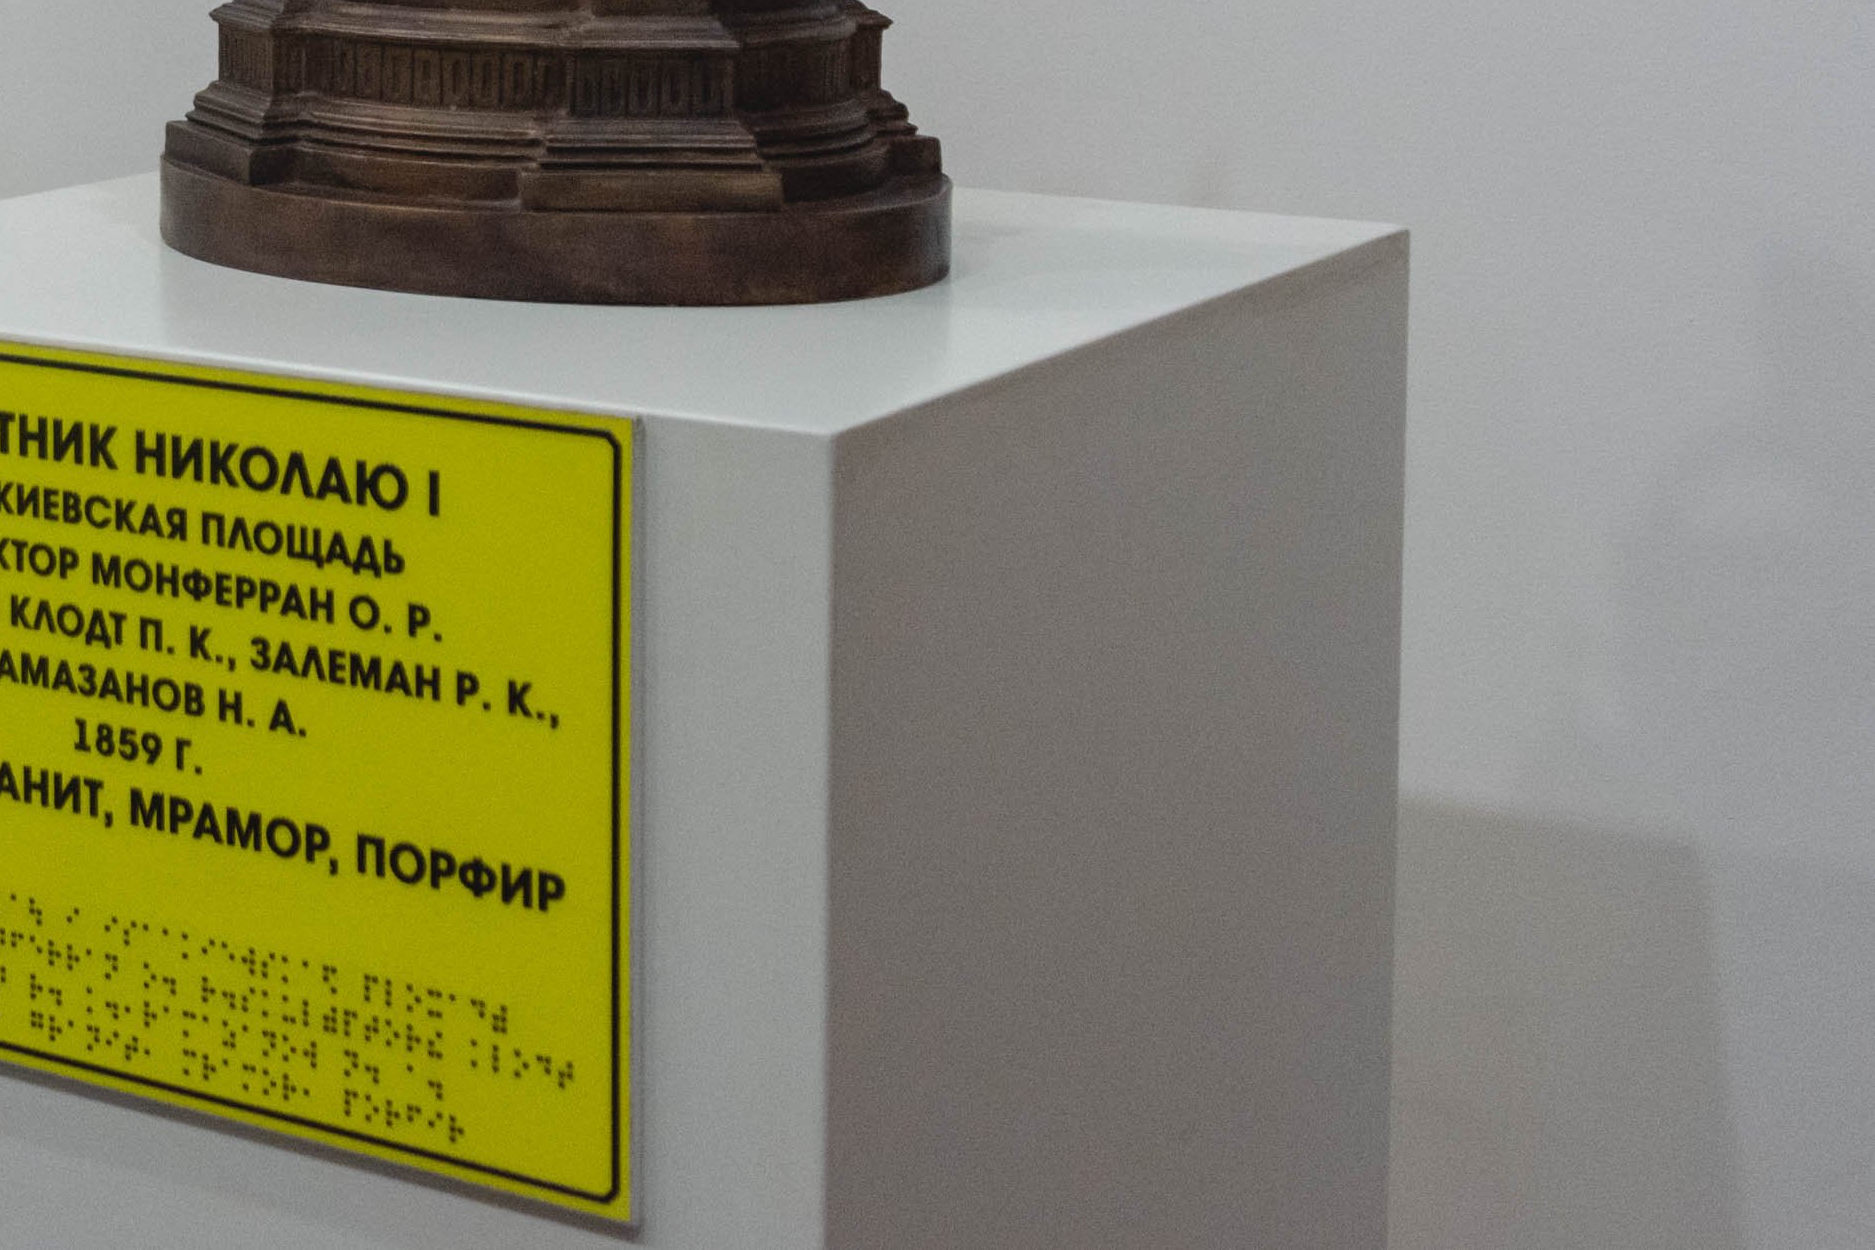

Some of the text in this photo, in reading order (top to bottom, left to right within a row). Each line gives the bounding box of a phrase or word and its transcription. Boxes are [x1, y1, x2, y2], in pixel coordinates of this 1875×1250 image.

[136, 431, 408, 511] НИКОЛАЮ
[202, 512, 405, 578] ПЛОЩАДЬ
[92, 553, 335, 624] МОНФЕРРАН
[348, 594, 392, 634] О.
[407, 603, 442, 643] Р.
[11, 595, 127, 649] КЛОДТ
[140, 616, 175, 655] П.
[189, 626, 236, 672] К.,
[251, 637, 441, 702] ЗАЛЕМАН
[455, 670, 491, 711] Р.
[507, 679, 559, 730] К.,
[74, 718, 202, 775] 1859 Г.
[218, 689, 255, 728] Н.
[268, 699, 307, 738] А.
[130, 788, 339, 876] МРАМОР,
[356, 833, 566, 913] ПОРФИР
